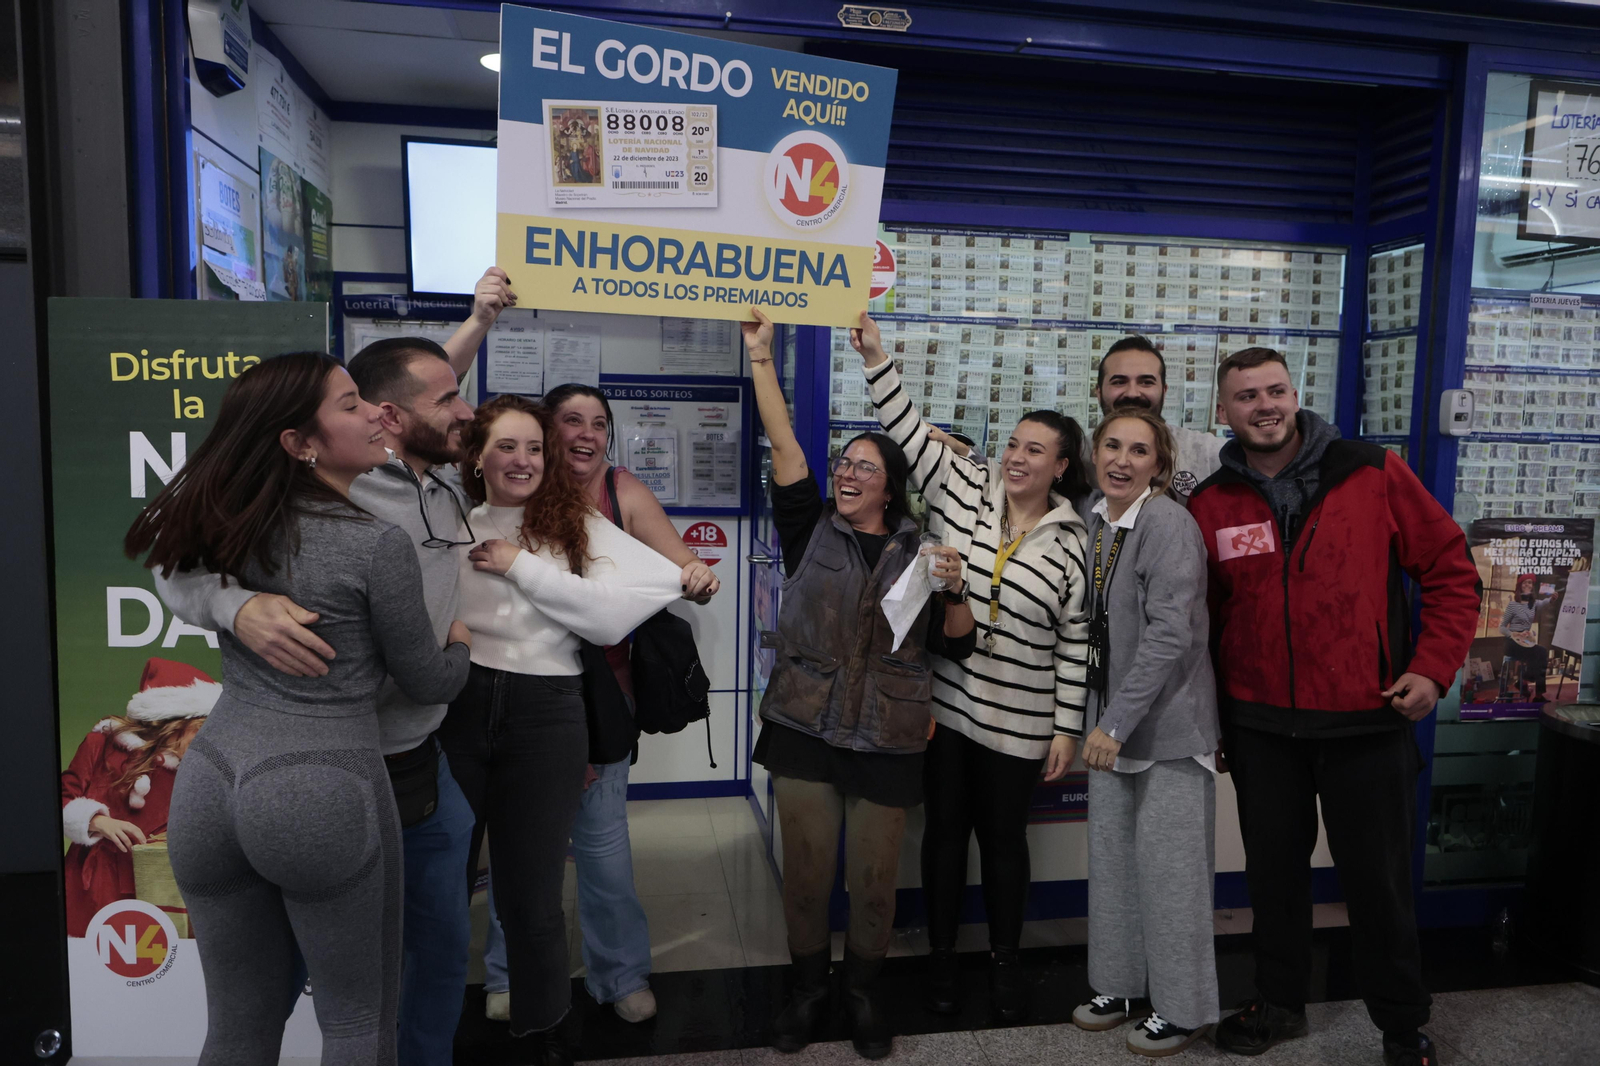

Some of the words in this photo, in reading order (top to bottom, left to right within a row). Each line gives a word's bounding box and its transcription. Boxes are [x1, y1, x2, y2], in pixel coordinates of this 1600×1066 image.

[532, 27, 585, 75] EL
[595, 39, 753, 98] GORDO
[771, 67, 869, 102] VENDIDO
[782, 98, 847, 126] AQUÍ!!
[606, 114, 684, 132] 88008
[694, 172, 708, 182] 20
[777, 155, 838, 204] N4
[824, 184, 848, 220] COMERCIAL
[796, 217, 822, 226] CENTRO
[526, 226, 852, 288] ENHORABUENA
[572, 276, 588, 294] A
[591, 278, 660, 300] TODOS
[664, 282, 699, 302] LOS
[703, 286, 808, 308] PREMIADOS
[1530, 296, 1557, 304] LOTERIA
[615, 389, 627, 397] DE
[630, 389, 648, 398] LOS
[650, 390, 693, 399] SORTEOS
[173, 389, 204, 419] la
[690, 526, 717, 541] +18
[1505, 524, 1525, 533] EURO
[1533, 524, 1564, 533] DREAMS
[1529, 539, 1561, 548] EUROS
[1563, 540, 1576, 548] AL
[1484, 548, 1503, 556] MES
[1506, 548, 1533, 557] PARA
[1535, 549, 1581, 557] CUMPLIR
[1491, 557, 1503, 566] TU
[1505, 556, 1537, 566] SUEÑO
[1539, 557, 1552, 566] DE
[1554, 557, 1574, 566] SER
[1509, 566, 1553, 575] PINTORA
[102, 925, 167, 964] N4
[156, 944, 178, 979] COMERCIAL
[126, 977, 155, 987] CENTRO
